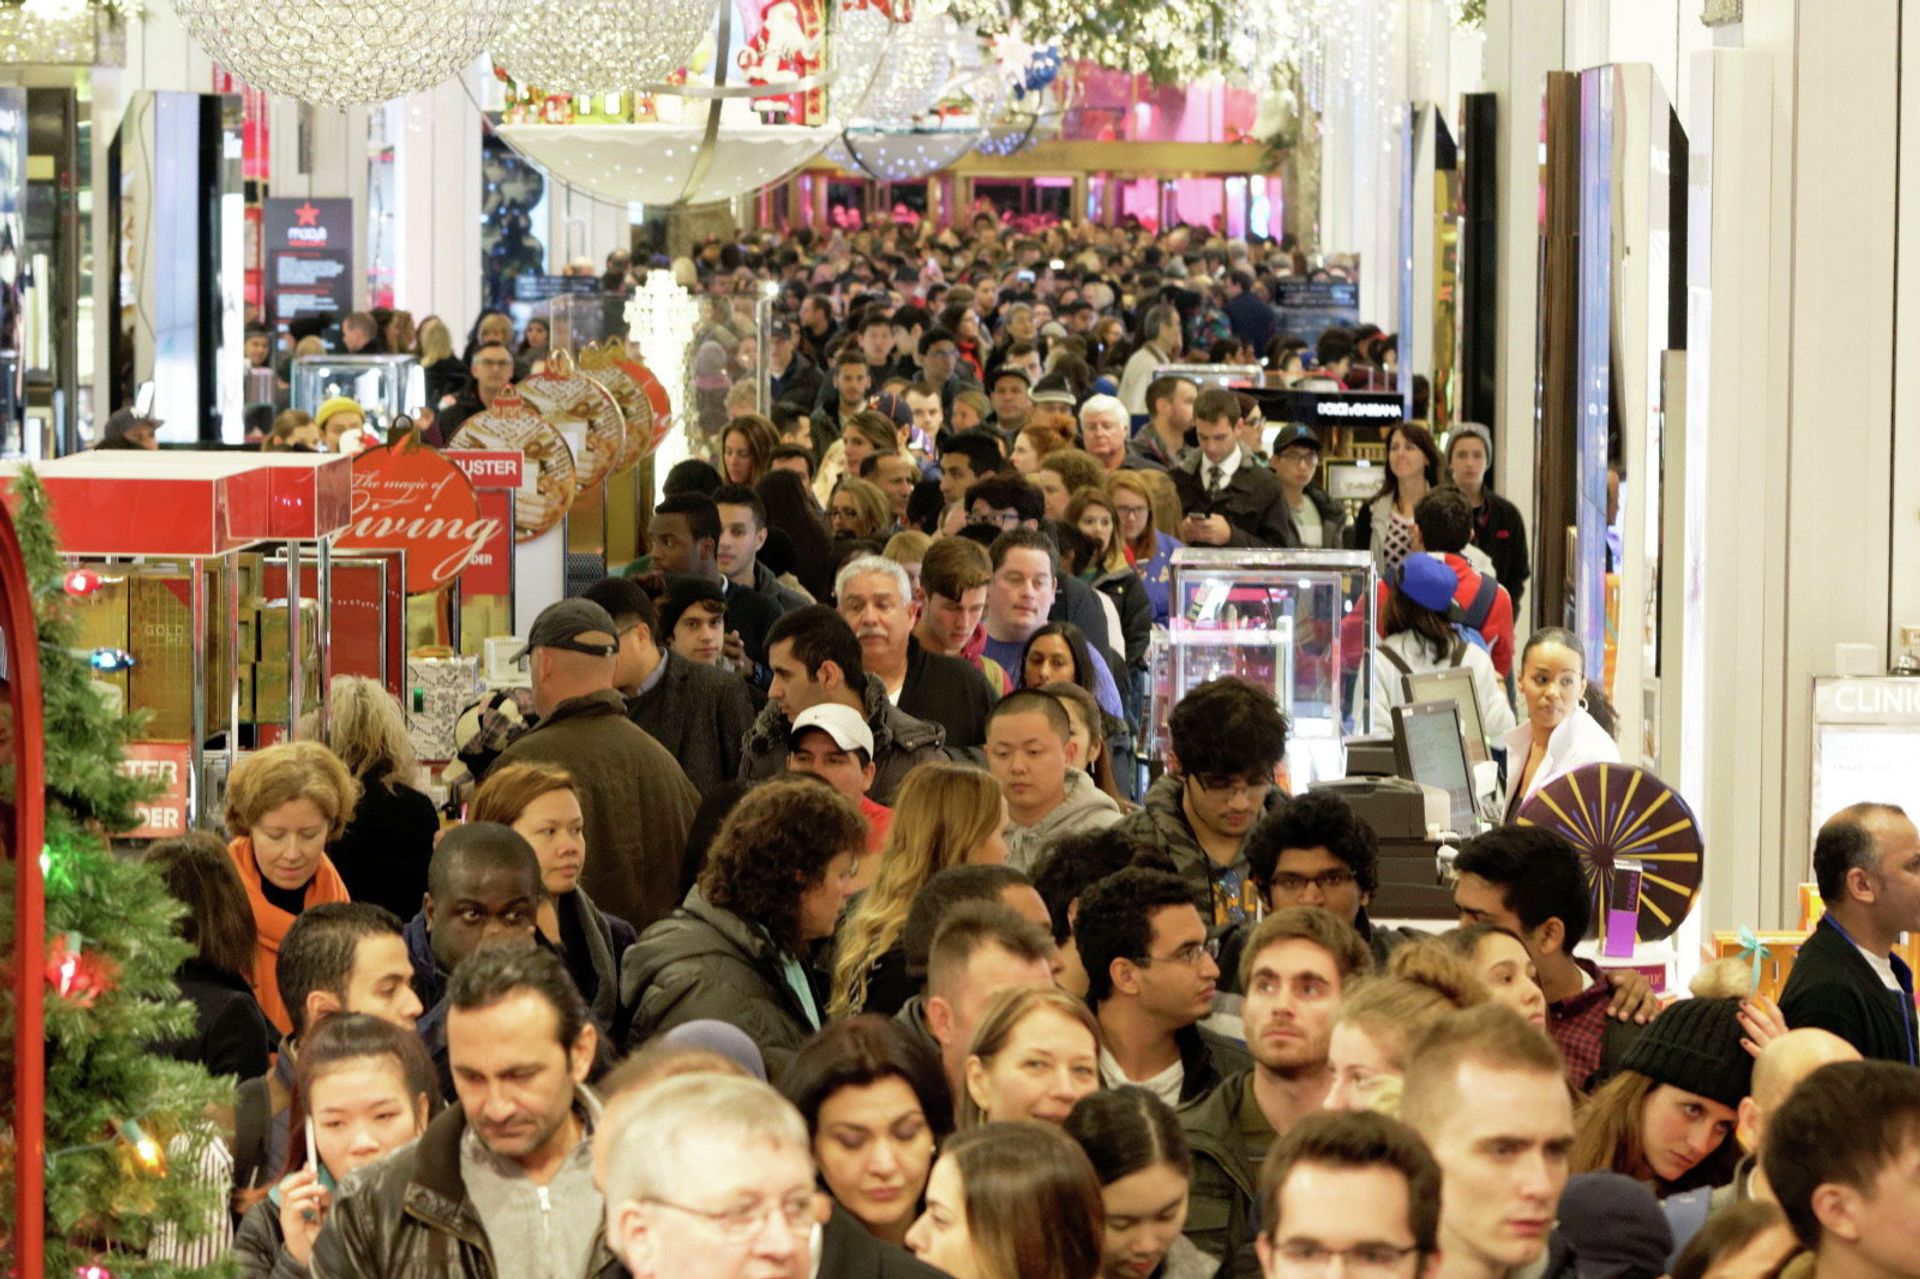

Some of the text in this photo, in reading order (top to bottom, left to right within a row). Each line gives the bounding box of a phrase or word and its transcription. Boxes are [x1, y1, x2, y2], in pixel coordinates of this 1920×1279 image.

[461, 459, 517, 475] USTER
[352, 470, 456, 506] The magic of
[470, 554, 493, 566] DER
[144, 624, 184, 637] GOLD
[134, 806, 179, 829] DER
